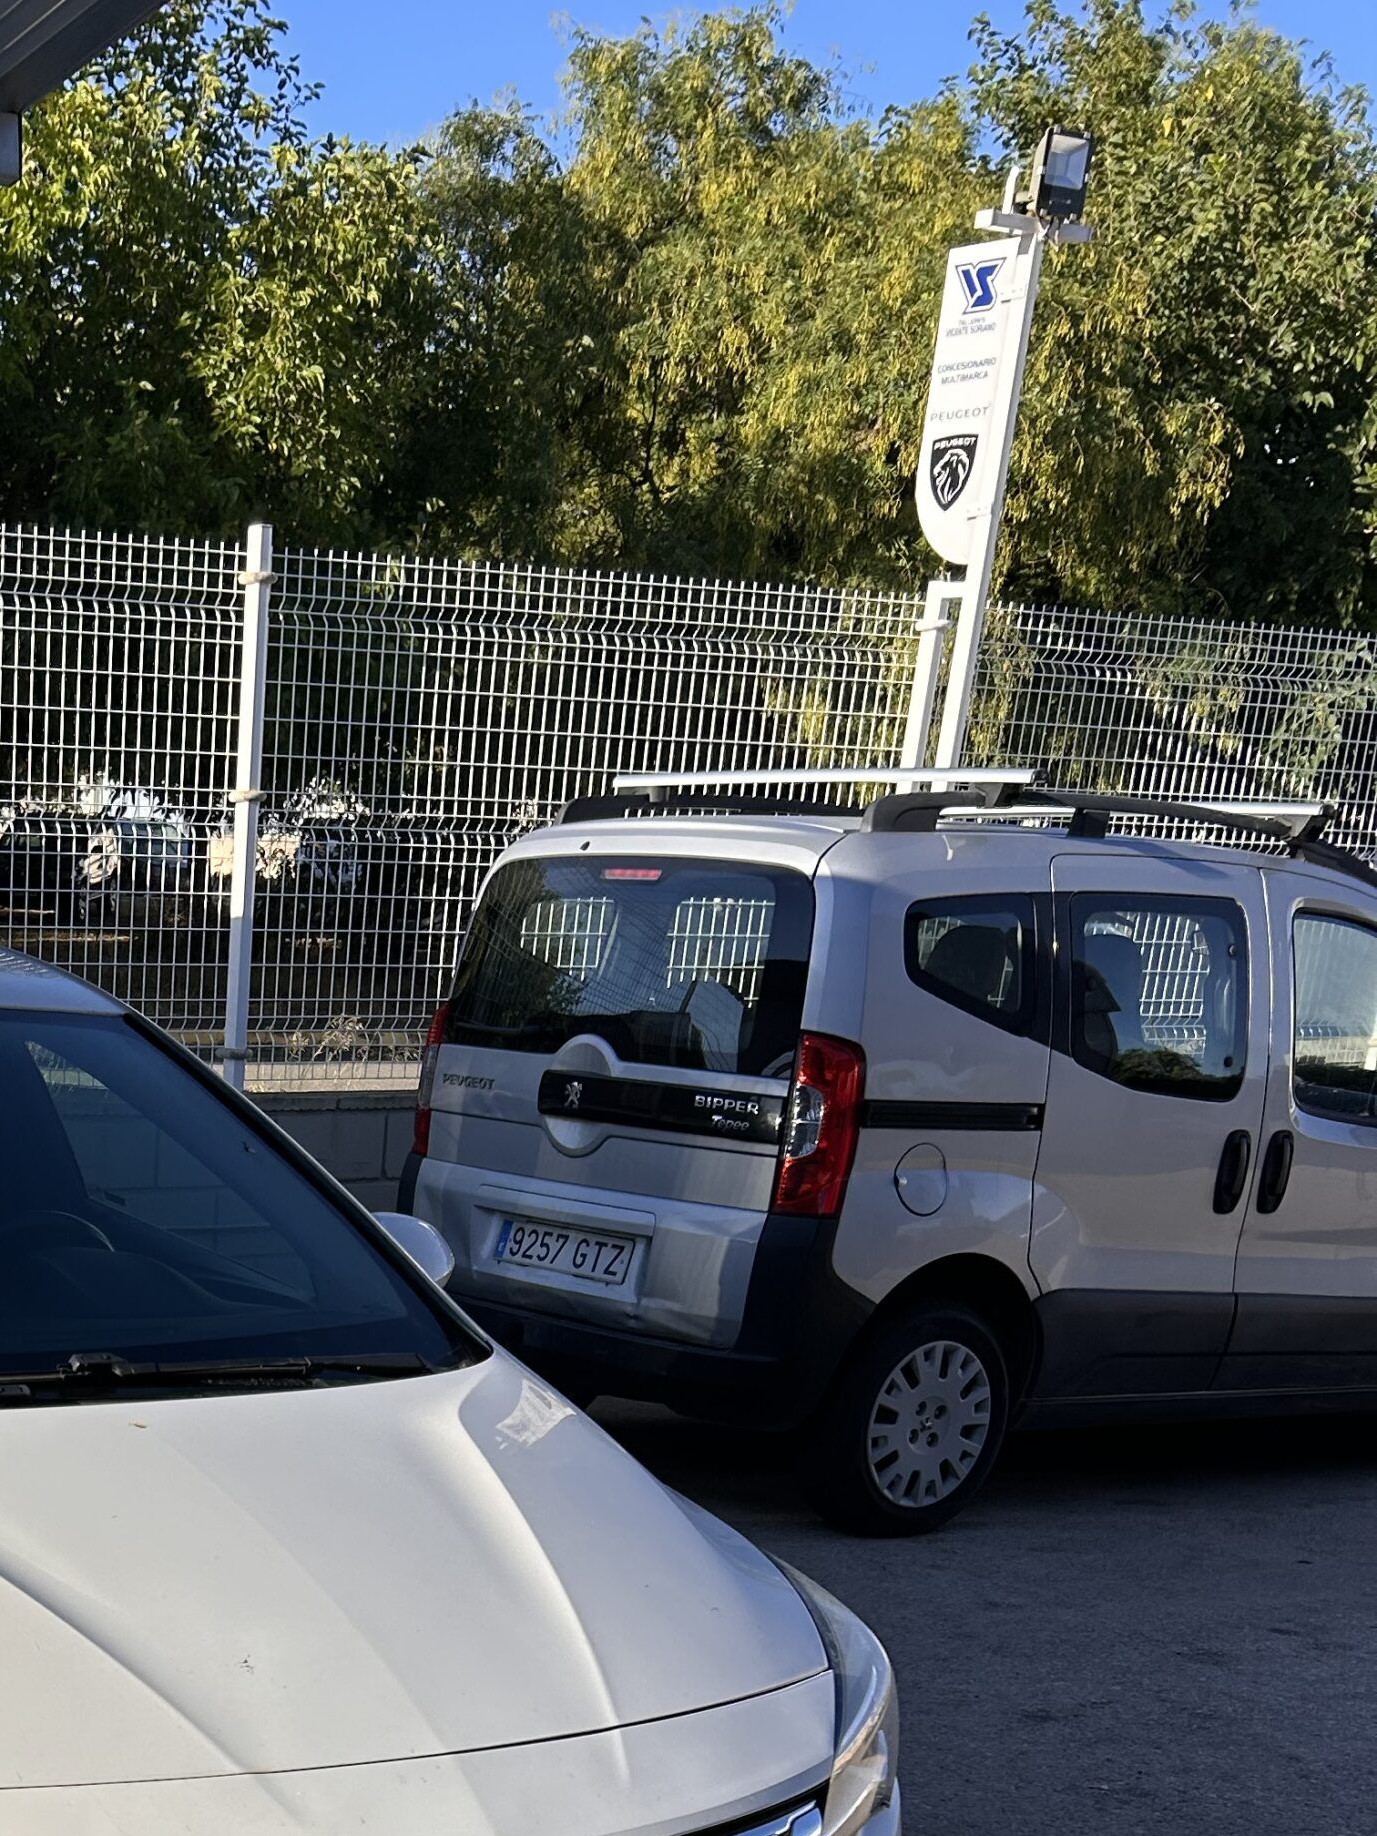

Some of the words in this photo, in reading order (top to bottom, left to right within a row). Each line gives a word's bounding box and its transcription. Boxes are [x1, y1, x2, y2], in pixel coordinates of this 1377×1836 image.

[937, 357, 997, 374] CONCESIONARIO
[941, 370, 988, 385] MULTIMARCA
[930, 406, 990, 422] PEUGEOT
[933, 437, 977, 450] PEUGEOT
[443, 1073, 495, 1089] PEUGEOT
[694, 1095, 759, 1115] BIPPER
[509, 1227, 570, 1264] 9257
[572, 1238, 626, 1276] GTZ
